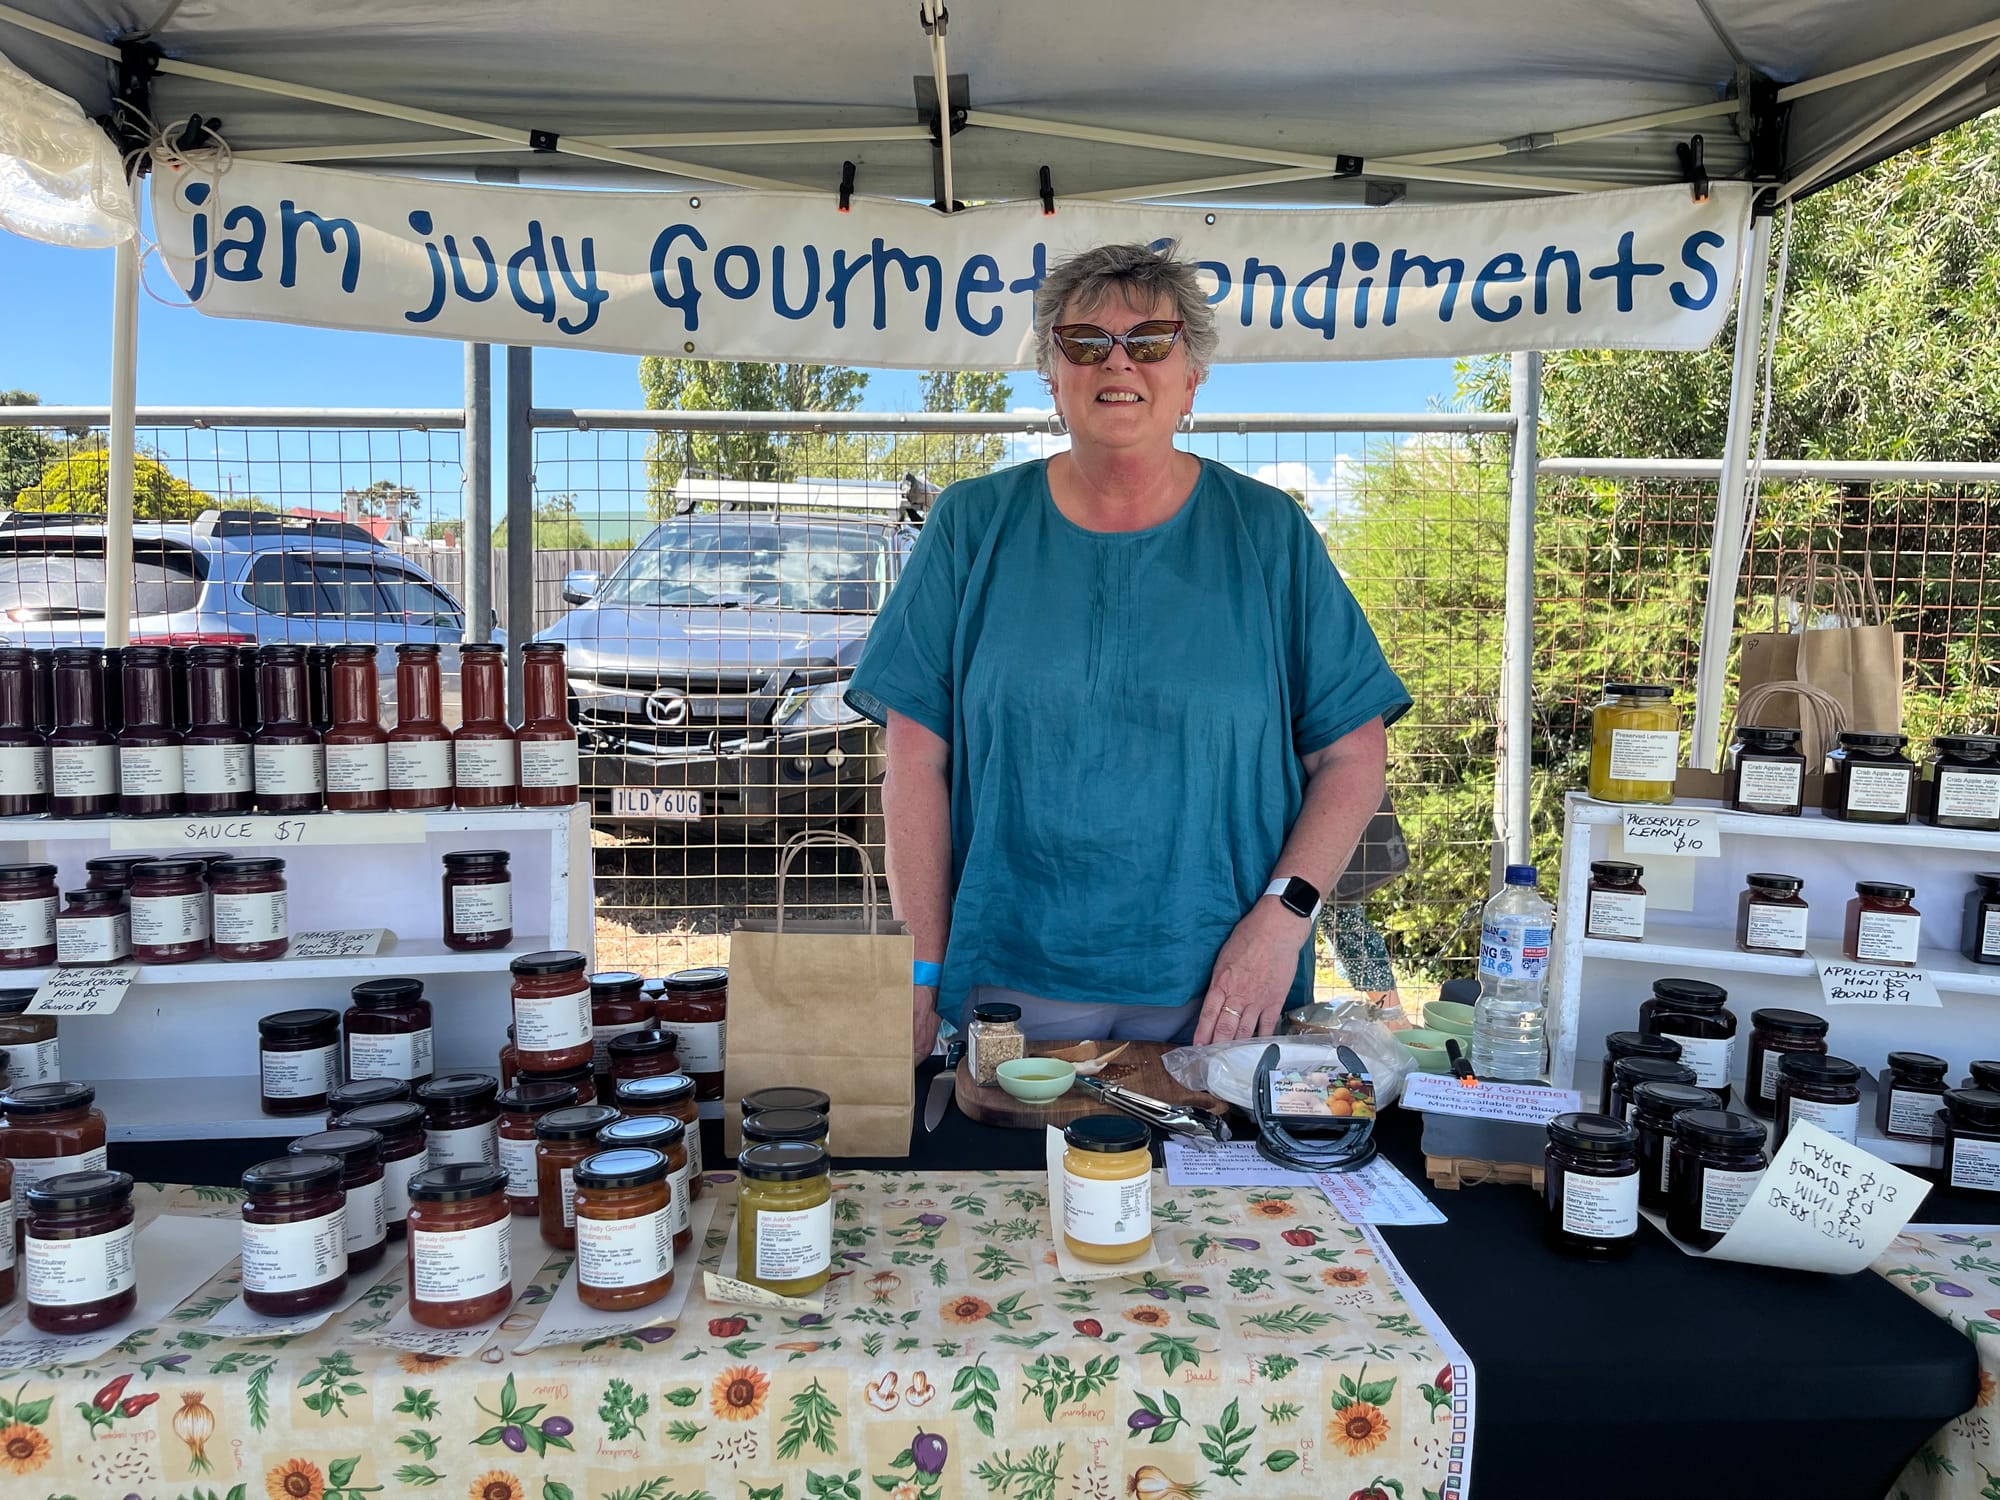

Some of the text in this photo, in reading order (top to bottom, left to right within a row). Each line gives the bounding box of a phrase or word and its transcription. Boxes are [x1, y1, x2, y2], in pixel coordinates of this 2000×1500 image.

[184, 181, 360, 303] jam
[404, 209, 610, 336] judy
[1147, 230, 1725, 340] ondiments
[1615, 732, 1668, 741] Preserved Lemons
[1763, 764, 1781, 772] Apple
[1782, 764, 1796, 773] Jelly
[664, 794, 697, 814] 6UG
[1626, 814, 1700, 828] PRESERVED
[185, 821, 306, 841] SAUCE $7
[1629, 827, 1680, 838] LEMON
[1674, 832, 1703, 852] $10
[340, 945, 364, 955] $9
[1824, 966, 1922, 982] APRICOT JAM
[1844, 977, 1907, 989] MINI $5
[83, 987, 105, 998] $5
[1831, 986, 1909, 1002] ROUND $9
[76, 1000, 97, 1011] $9
[1419, 1076, 1569, 1099] Jam Gourmet
[1415, 1091, 1460, 1103] Products
[1464, 1098, 1512, 1108] available
[1445, 1088, 1539, 1104] Condiments
[1428, 1101, 1476, 1112] Martha's
[1507, 1110, 1545, 1120] Bunyip
[1567, 1196, 1582, 1205] Berry
[1706, 1194, 1723, 1202] Berry
[589, 1223, 636, 1233] Judy Gourmet
[41, 1258, 66, 1267] Chutney
[1184, 1368, 1217, 1384] Basil
[1300, 1438, 1315, 1476] Basil
